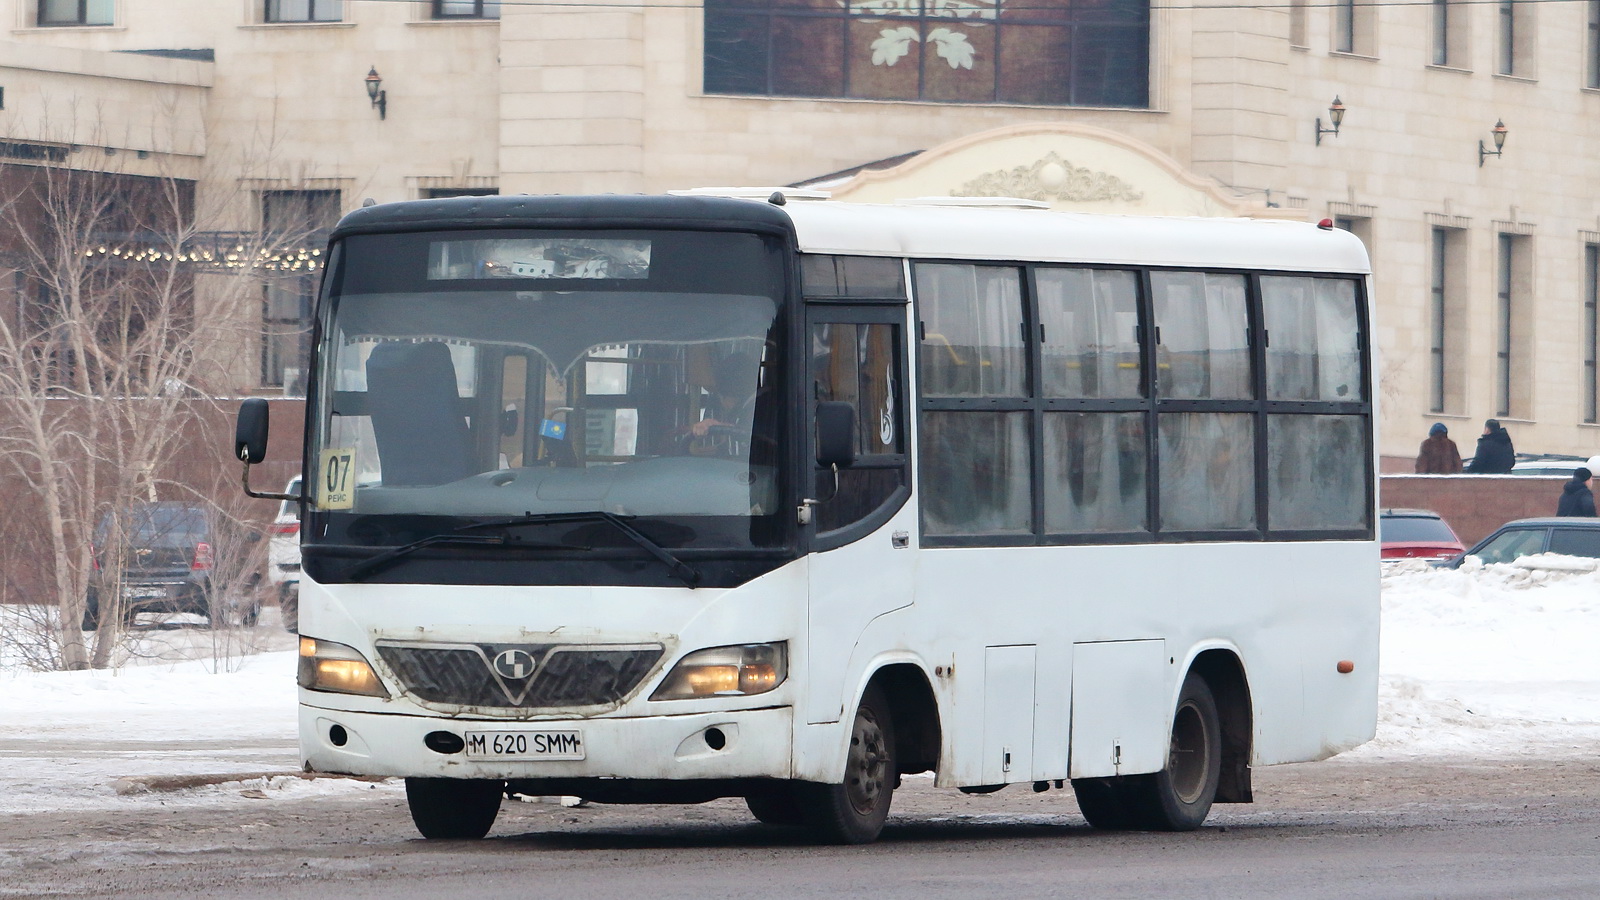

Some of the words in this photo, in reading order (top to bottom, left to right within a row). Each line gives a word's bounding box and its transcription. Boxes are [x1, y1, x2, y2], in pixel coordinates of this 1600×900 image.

[327, 455, 351, 492] 07
[472, 734, 486, 754] M
[493, 734, 527, 754] 620
[534, 733, 577, 753] SMM
